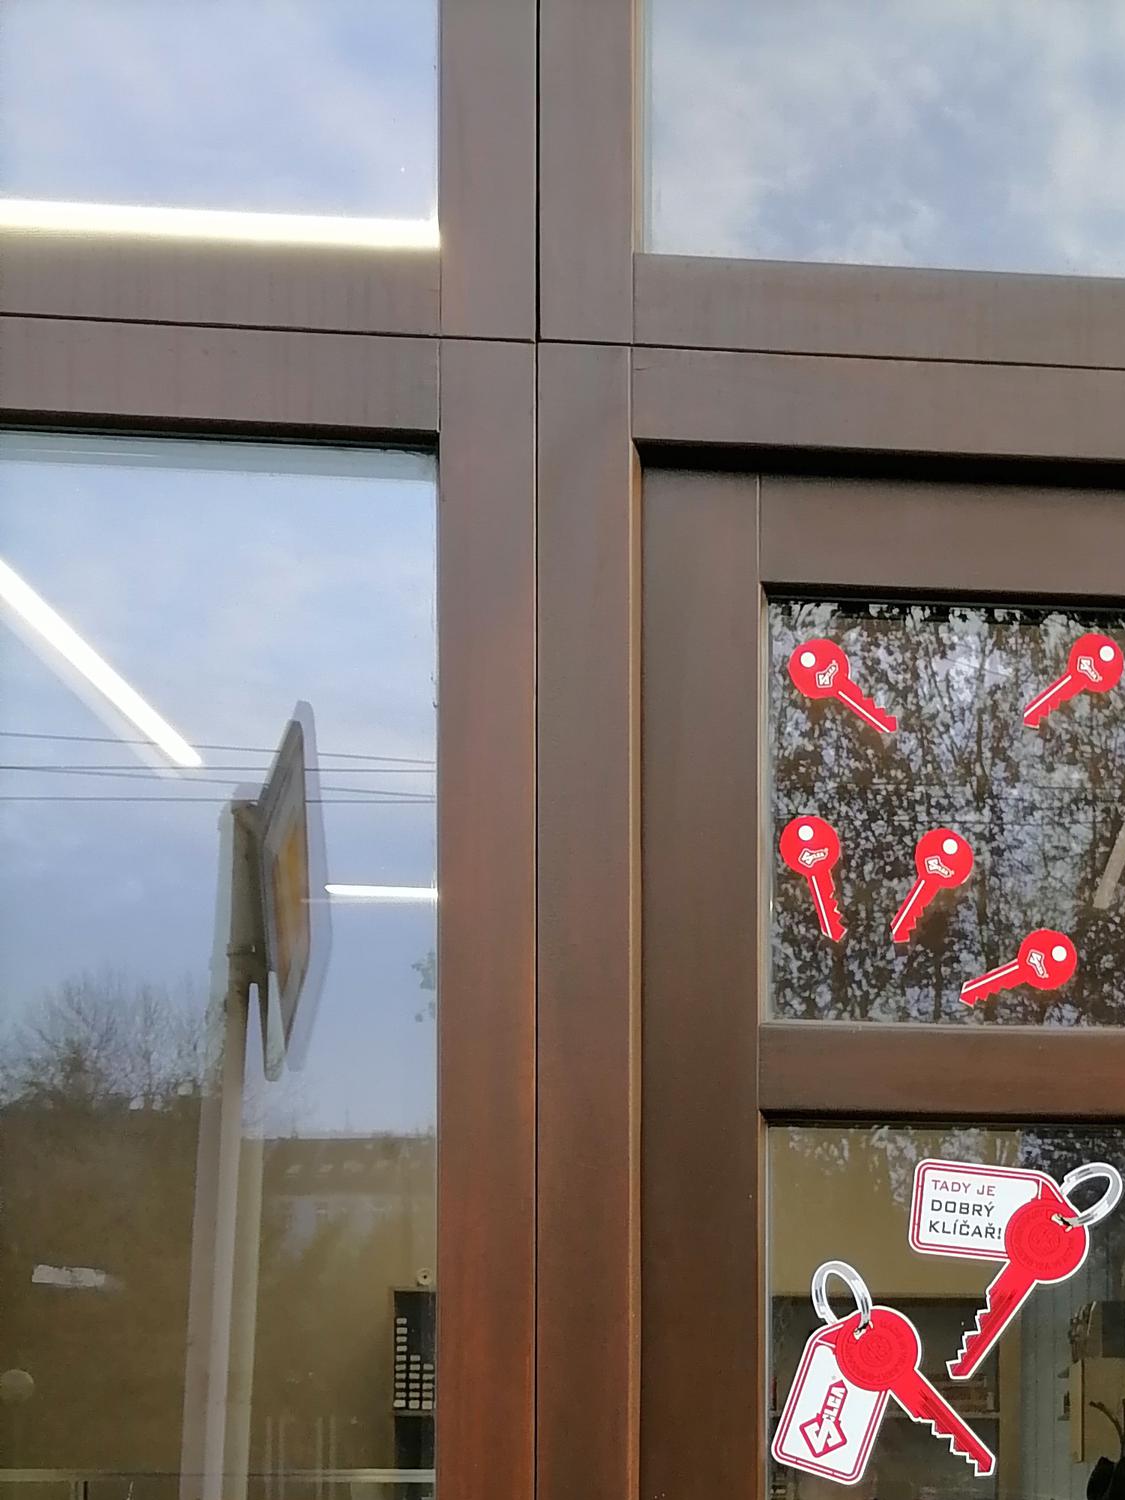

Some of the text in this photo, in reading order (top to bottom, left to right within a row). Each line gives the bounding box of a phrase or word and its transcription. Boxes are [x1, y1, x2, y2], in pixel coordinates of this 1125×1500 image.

[931, 1179, 996, 1196] TADY JE
[930, 1199, 996, 1217] DOBRÝ
[928, 1219, 1003, 1240] KLÍČAŘ!
[803, 1386, 846, 1454] SILCA
